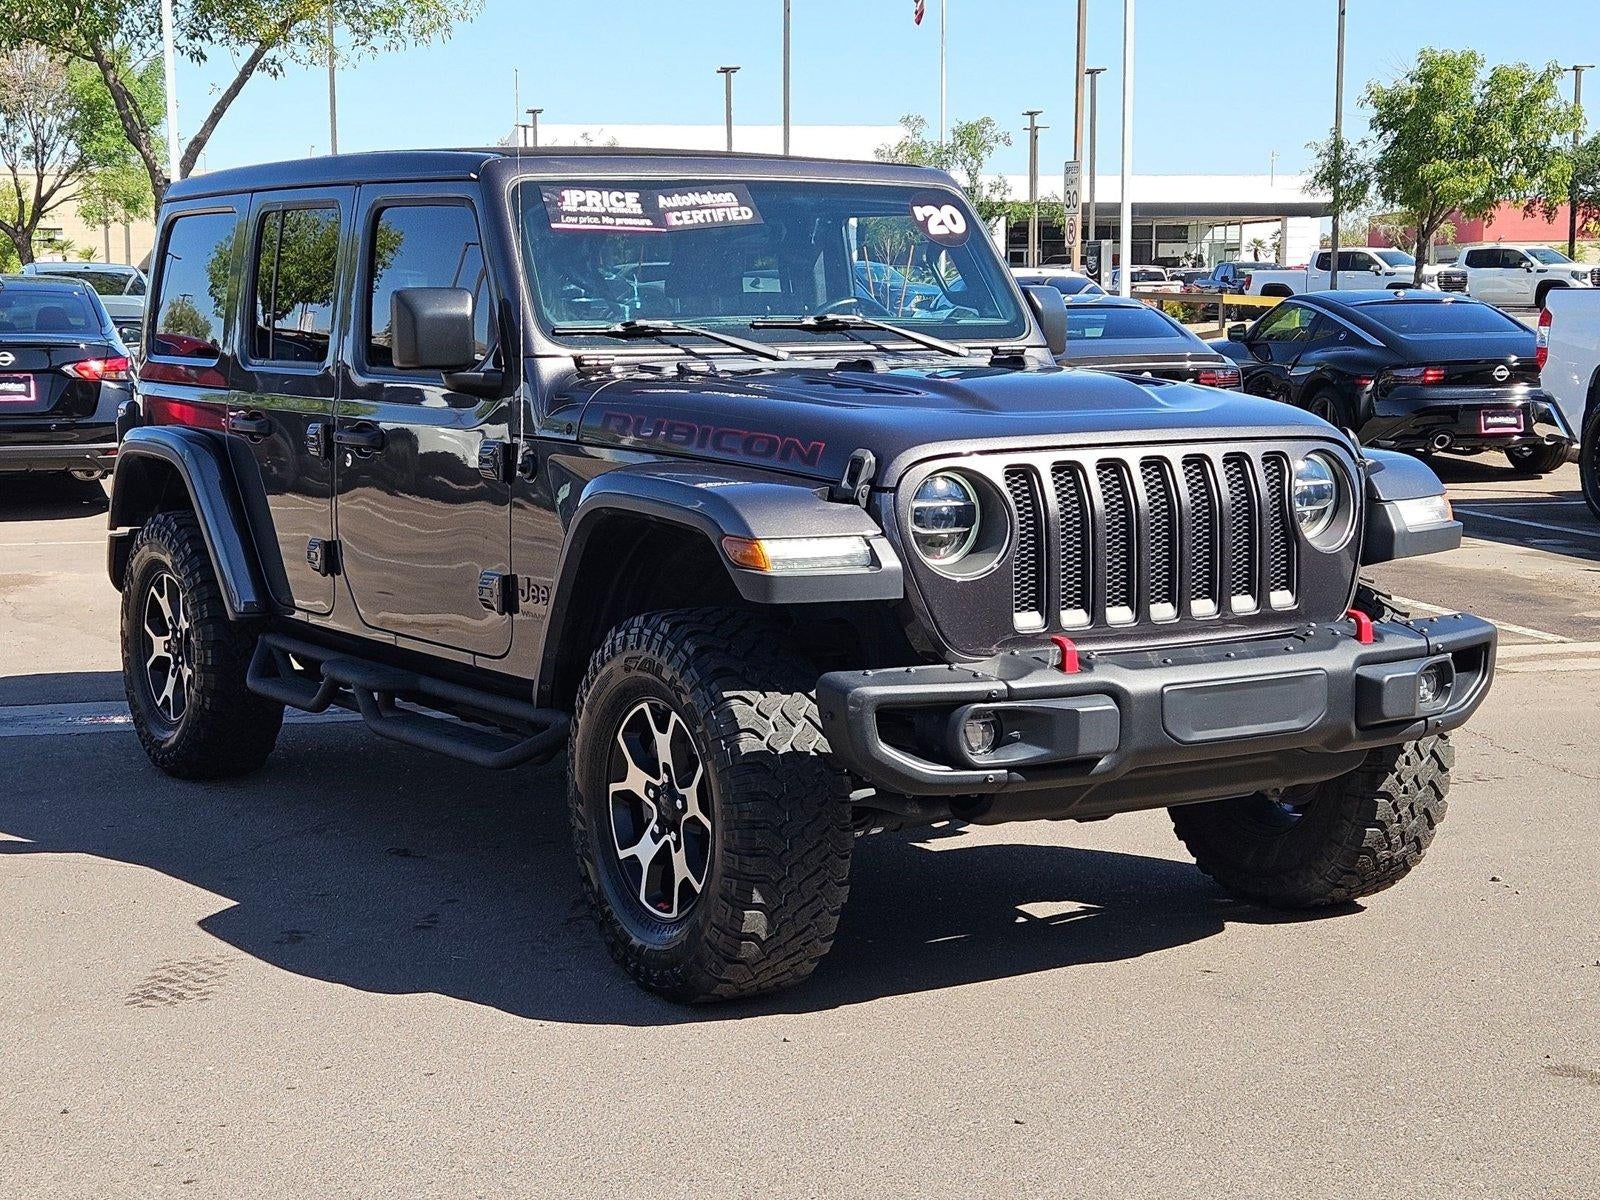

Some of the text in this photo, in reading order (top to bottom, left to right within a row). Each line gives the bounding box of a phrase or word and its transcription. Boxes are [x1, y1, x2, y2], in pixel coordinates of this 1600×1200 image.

[658, 191, 738, 208] AutoNation
[1065, 189, 1078, 209] 30
[561, 215, 578, 224] Low
[580, 216, 600, 225] price.
[602, 215, 614, 224] No
[671, 206, 754, 226] CERTIFIED
[601, 410, 826, 467] RUBICON
[519, 577, 552, 606] Jee
